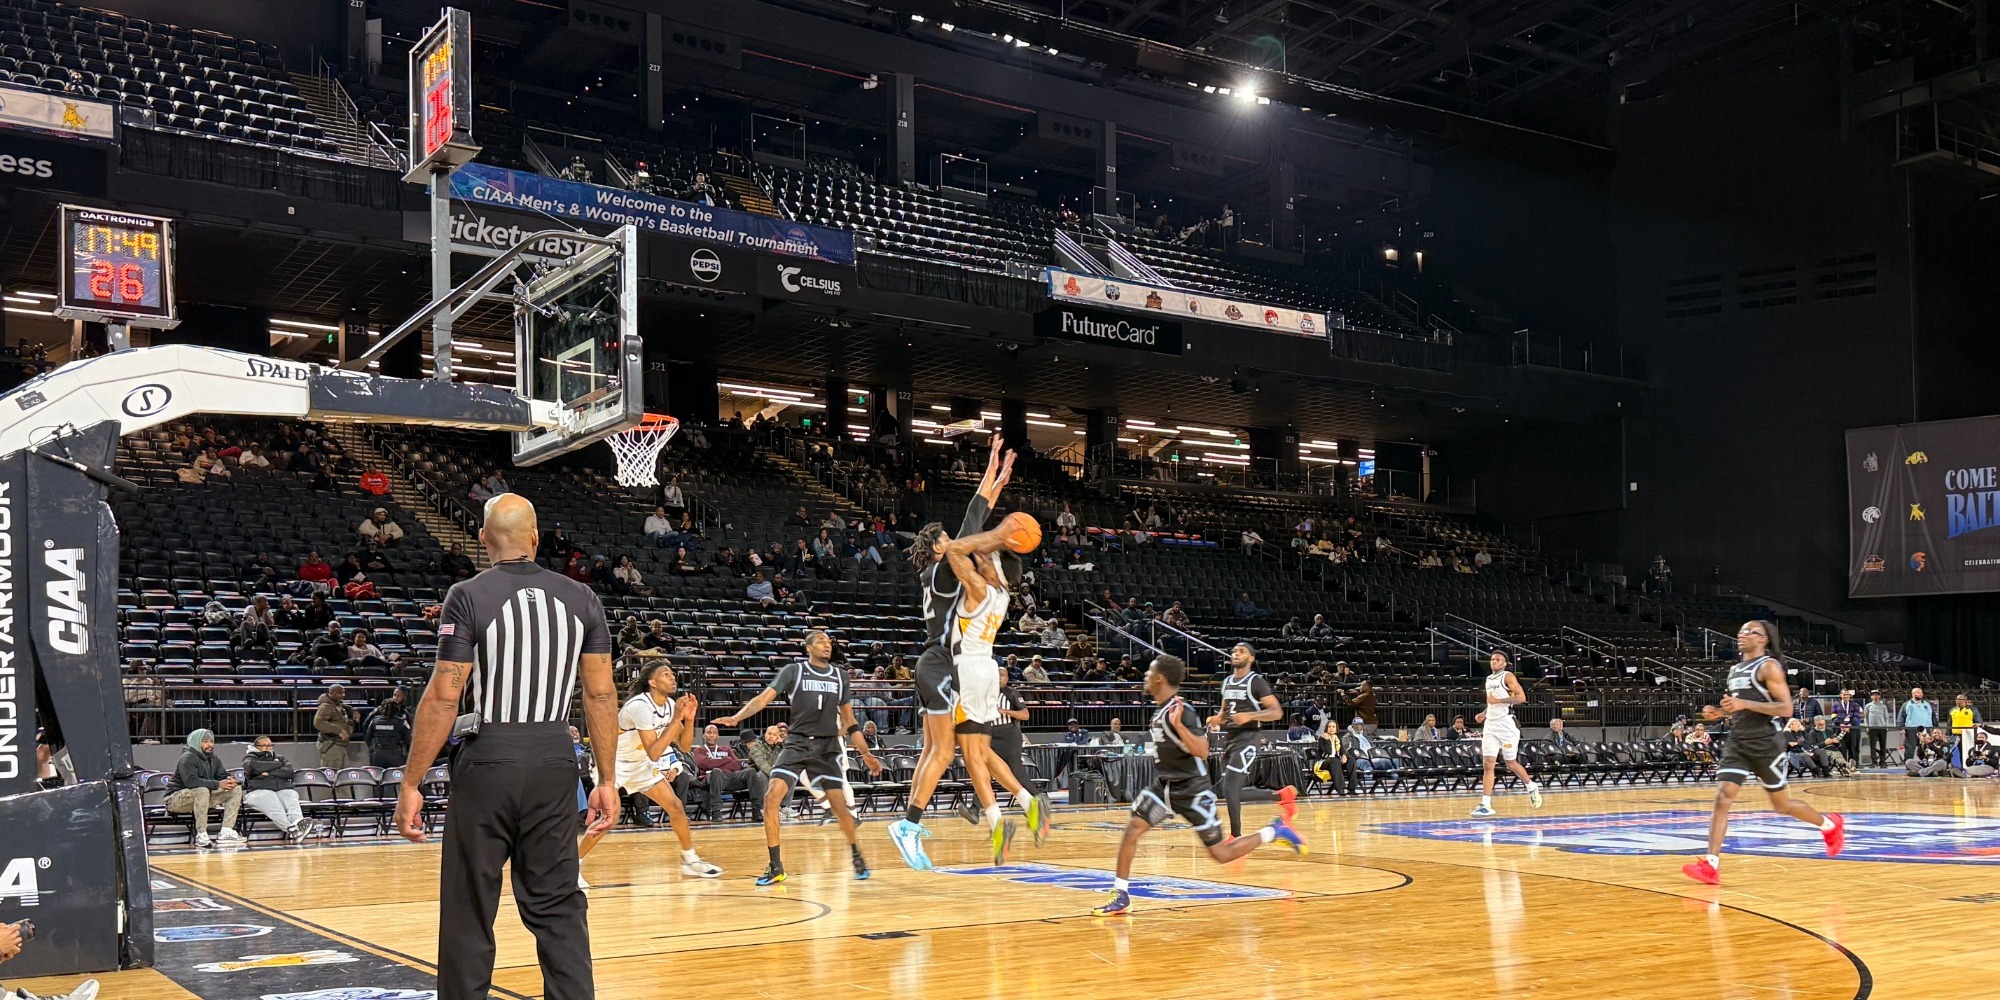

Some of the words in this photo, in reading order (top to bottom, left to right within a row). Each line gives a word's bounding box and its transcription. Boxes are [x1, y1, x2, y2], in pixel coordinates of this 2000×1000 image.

[649, 63, 661, 72] 217
[426, 79, 452, 154] 26
[596, 190, 666, 214] Welcome
[670, 204, 686, 218] to
[689, 205, 713, 222] the
[80, 211, 155, 227] DAKTRONICS
[472, 186, 514, 205] CIAA
[520, 193, 565, 213] Men's
[569, 203, 580, 216] &
[585, 205, 655, 229] Women's
[659, 218, 734, 243] Basketball
[738, 231, 819, 257] Tournament
[87, 225, 157, 260] 17:49
[450, 214, 599, 257] ticketmast
[692, 260, 719, 271] PEPSI
[89, 258, 145, 301] 26
[800, 275, 841, 291] CELSIUS
[246, 358, 342, 381] SPALD
[650, 362, 666, 372] 121
[898, 391, 912, 401] 122
[1945, 466, 1998, 491] COME
[817, 694, 823, 710] 1
[1229, 701, 1237, 714] 2
